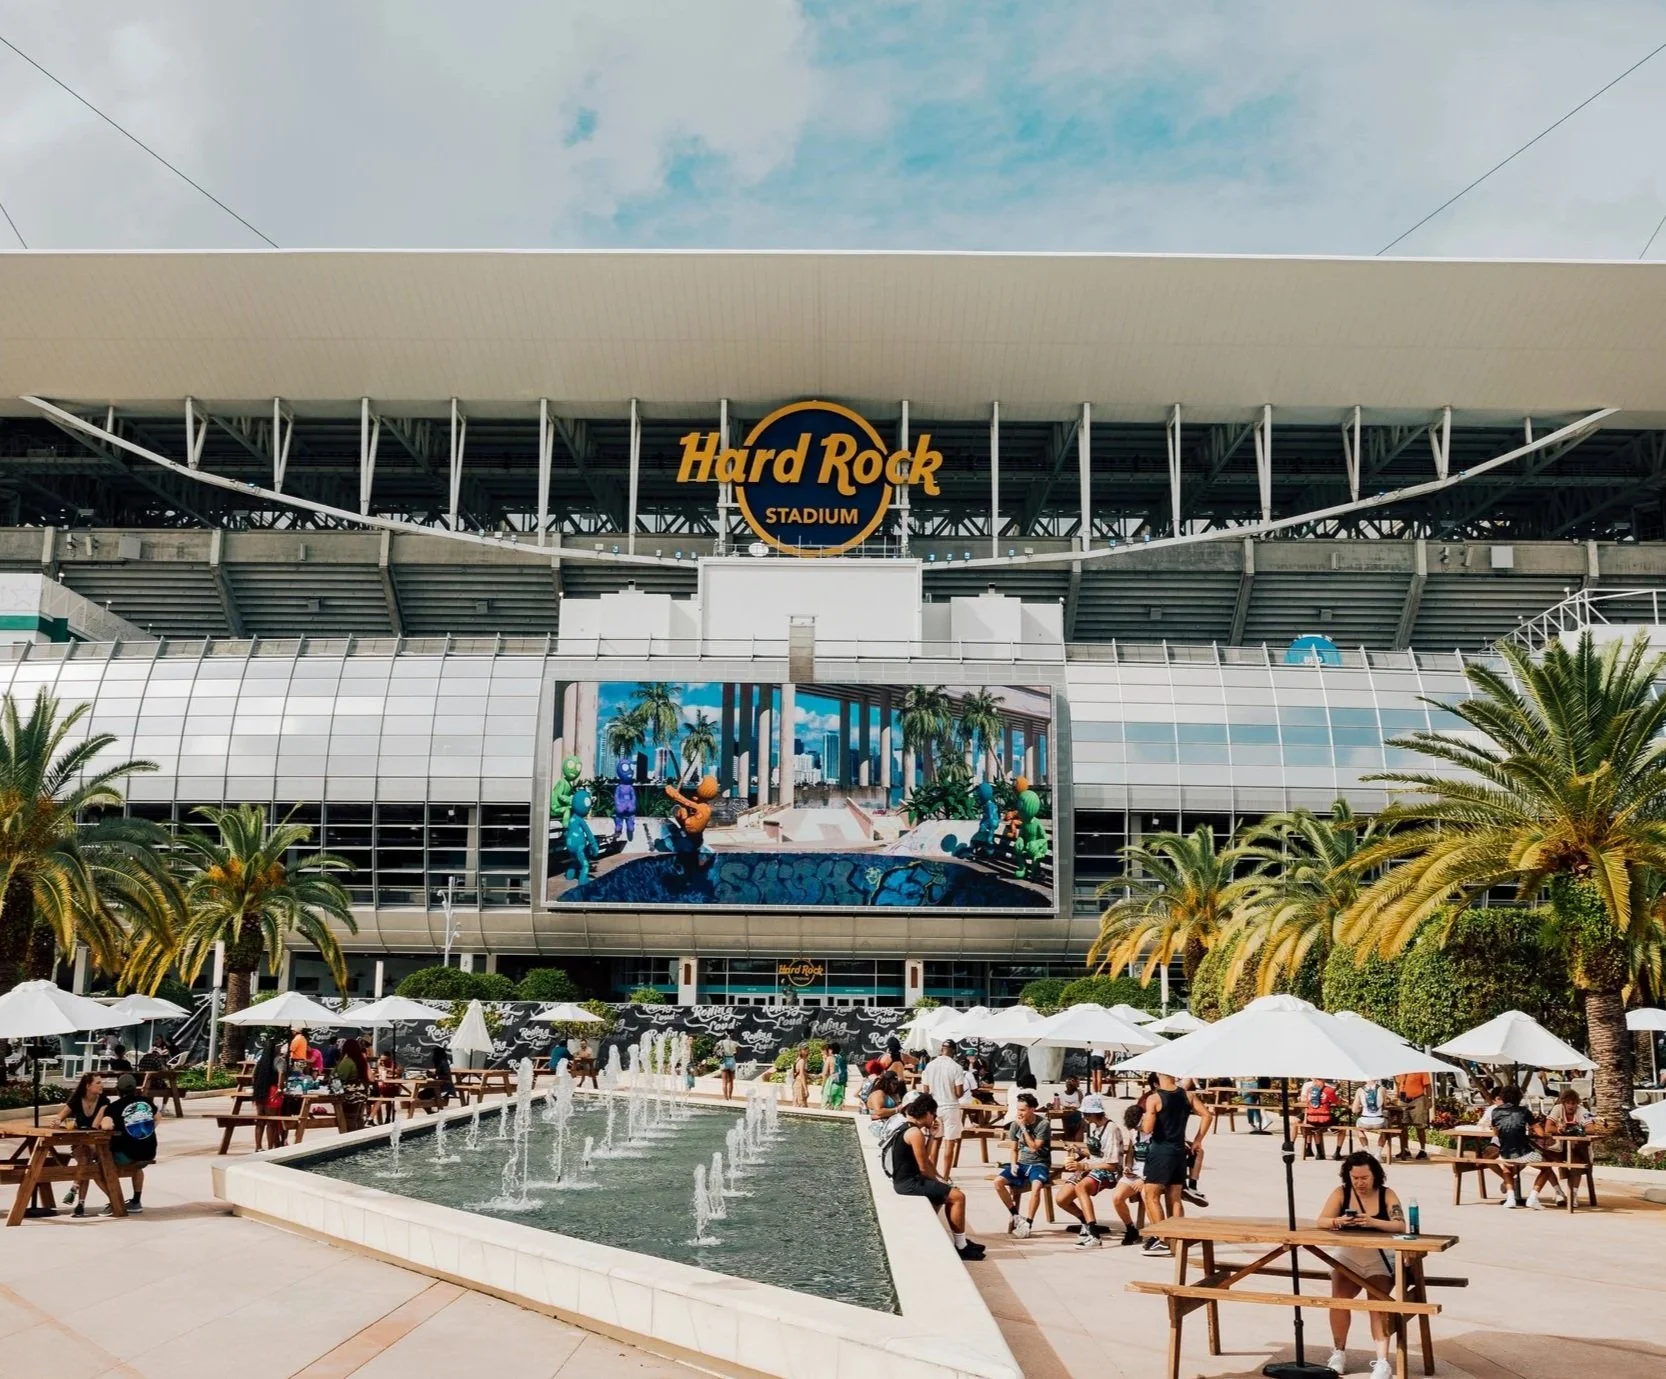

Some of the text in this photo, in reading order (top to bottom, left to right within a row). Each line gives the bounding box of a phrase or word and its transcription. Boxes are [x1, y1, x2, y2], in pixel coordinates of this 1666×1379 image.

[676, 432, 943, 496] Hard Rock
[765, 507, 858, 524] STADIUM
[779, 964, 824, 976] Hard Rock
[691, 1005, 747, 1022] Rolling
[809, 1017, 860, 1039] Rolling
